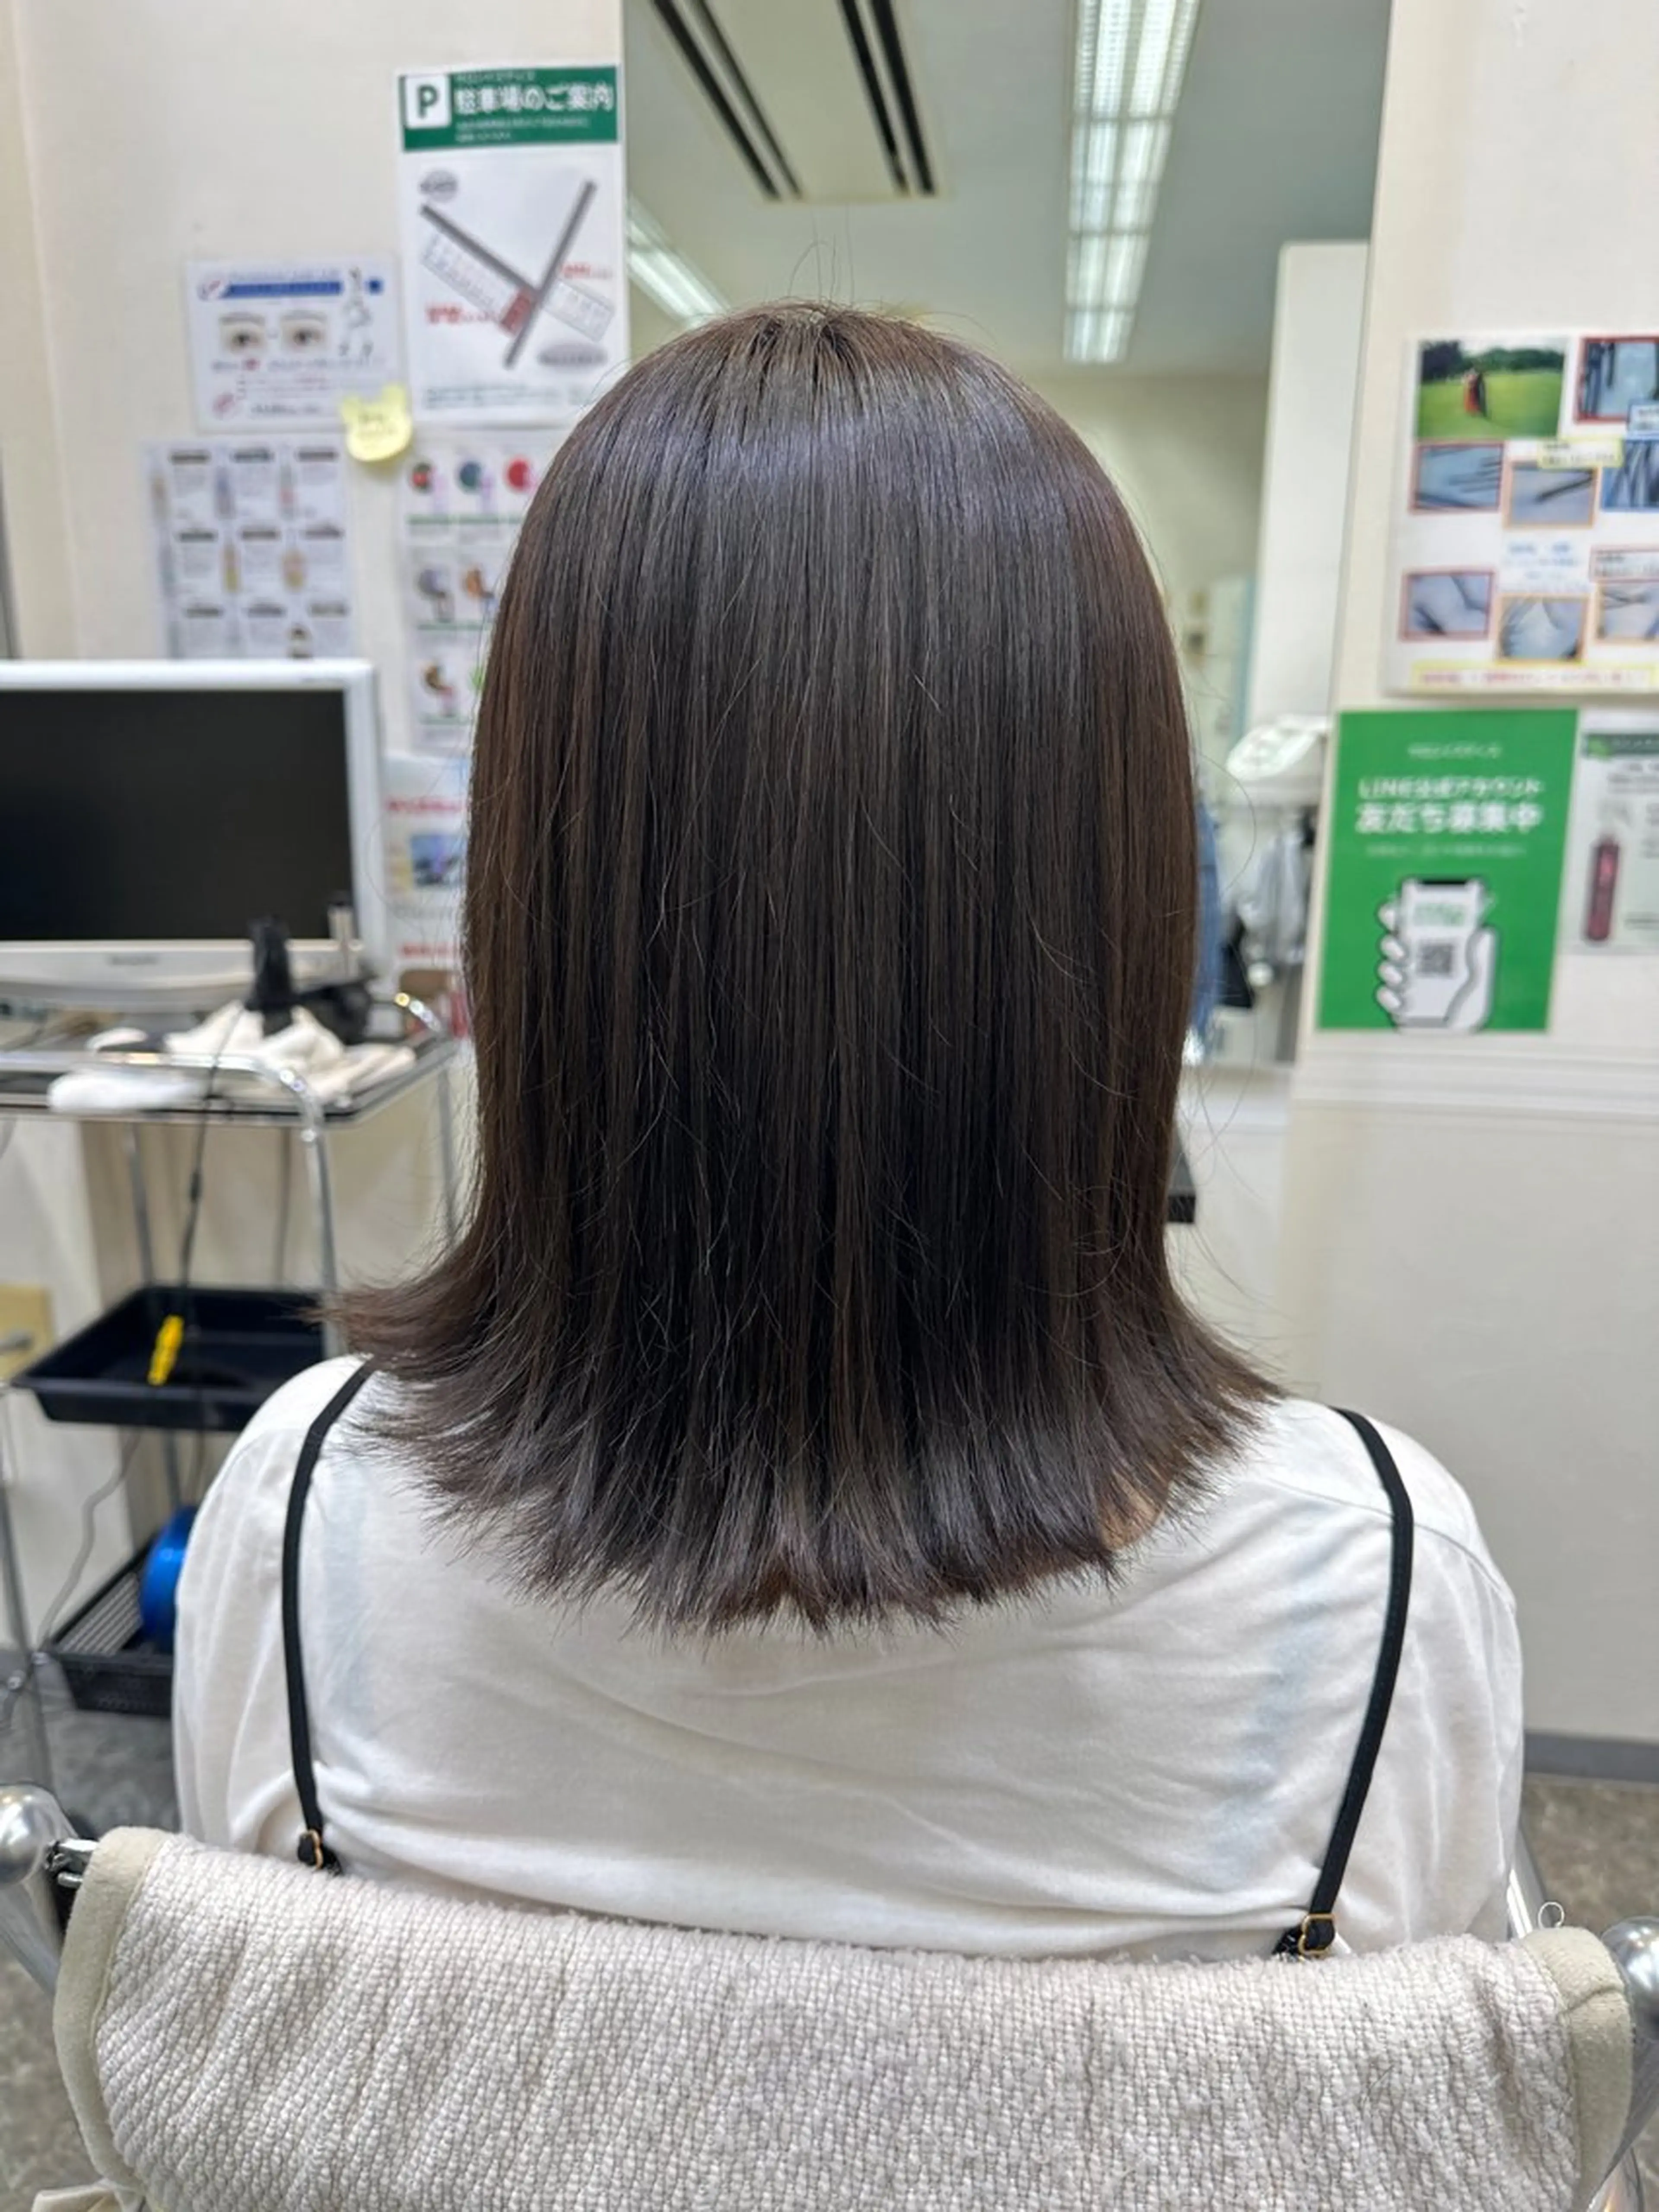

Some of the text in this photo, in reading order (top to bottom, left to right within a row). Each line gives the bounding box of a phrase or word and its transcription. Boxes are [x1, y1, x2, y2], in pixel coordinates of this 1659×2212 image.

[418, 85, 438, 118] P
[454, 81, 613, 115] 駐車場のご案内
[1355, 802, 1544, 834] 友だち募集中
